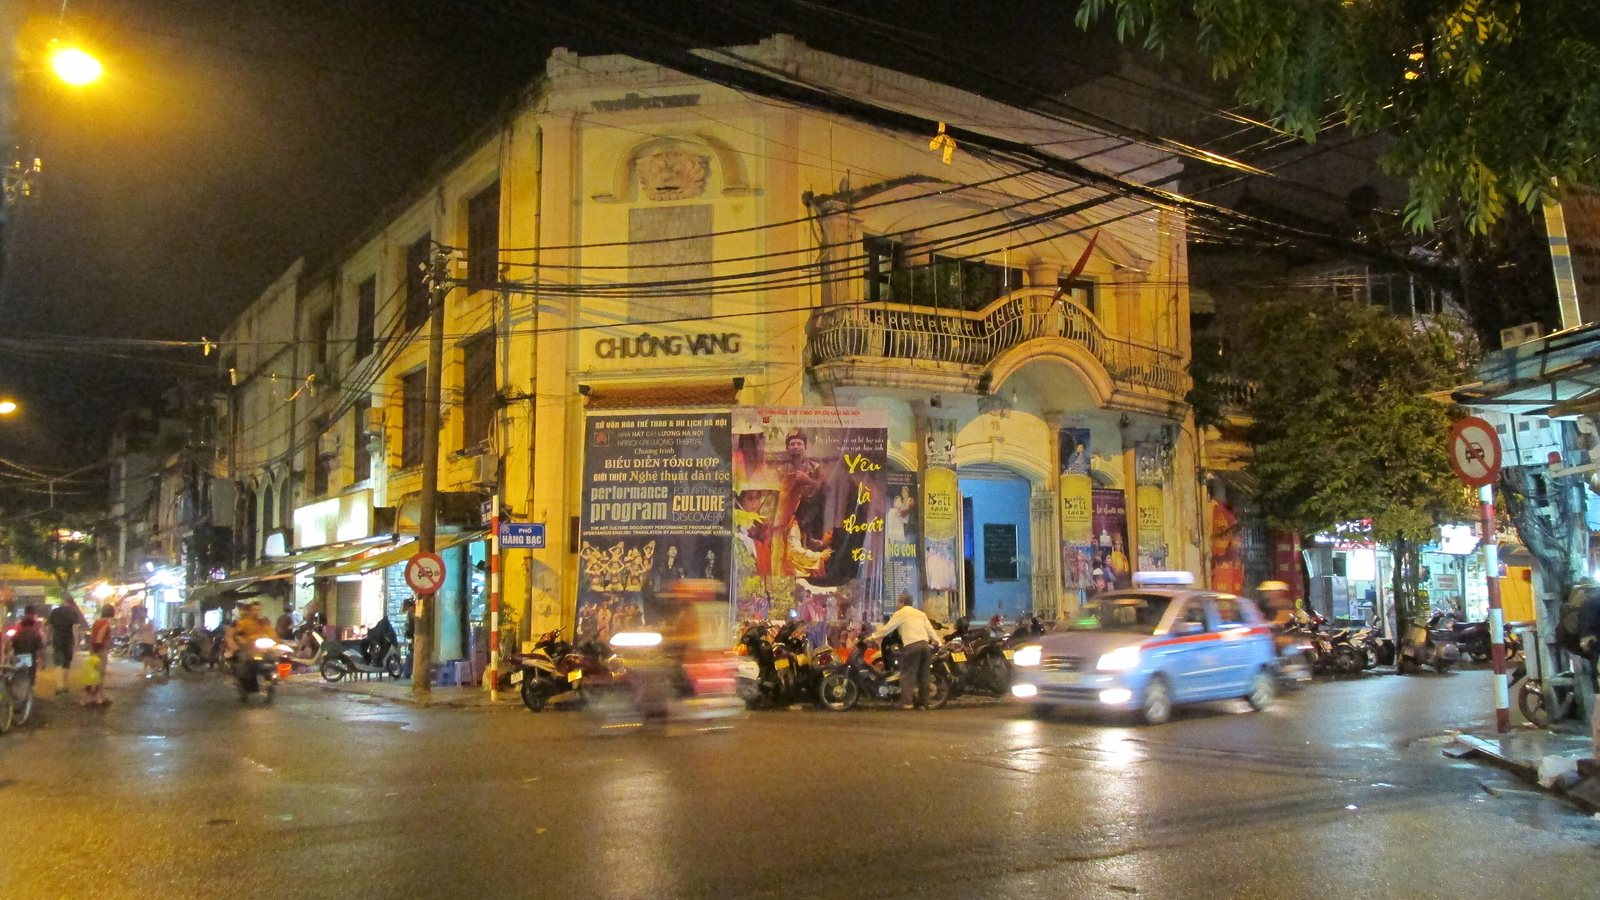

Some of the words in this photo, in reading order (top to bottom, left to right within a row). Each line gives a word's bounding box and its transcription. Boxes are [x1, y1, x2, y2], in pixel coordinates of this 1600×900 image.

[595, 332, 684, 358] CHUÔNG
[696, 458, 720, 469] HỢP
[844, 453, 882, 474] Yêu
[629, 470, 658, 484] Nghệ
[660, 470, 688, 484] thuật
[691, 470, 712, 480] dân
[714, 470, 730, 484] tộc
[591, 486, 668, 501] performance
[857, 481, 872, 505] là
[672, 495, 725, 512] CULTURE
[590, 502, 667, 523] program
[672, 512, 725, 521] DISCOVERY
[843, 514, 884, 534] thoát
[502, 533, 524, 544] HÀNG
[526, 536, 541, 546] BẠC
